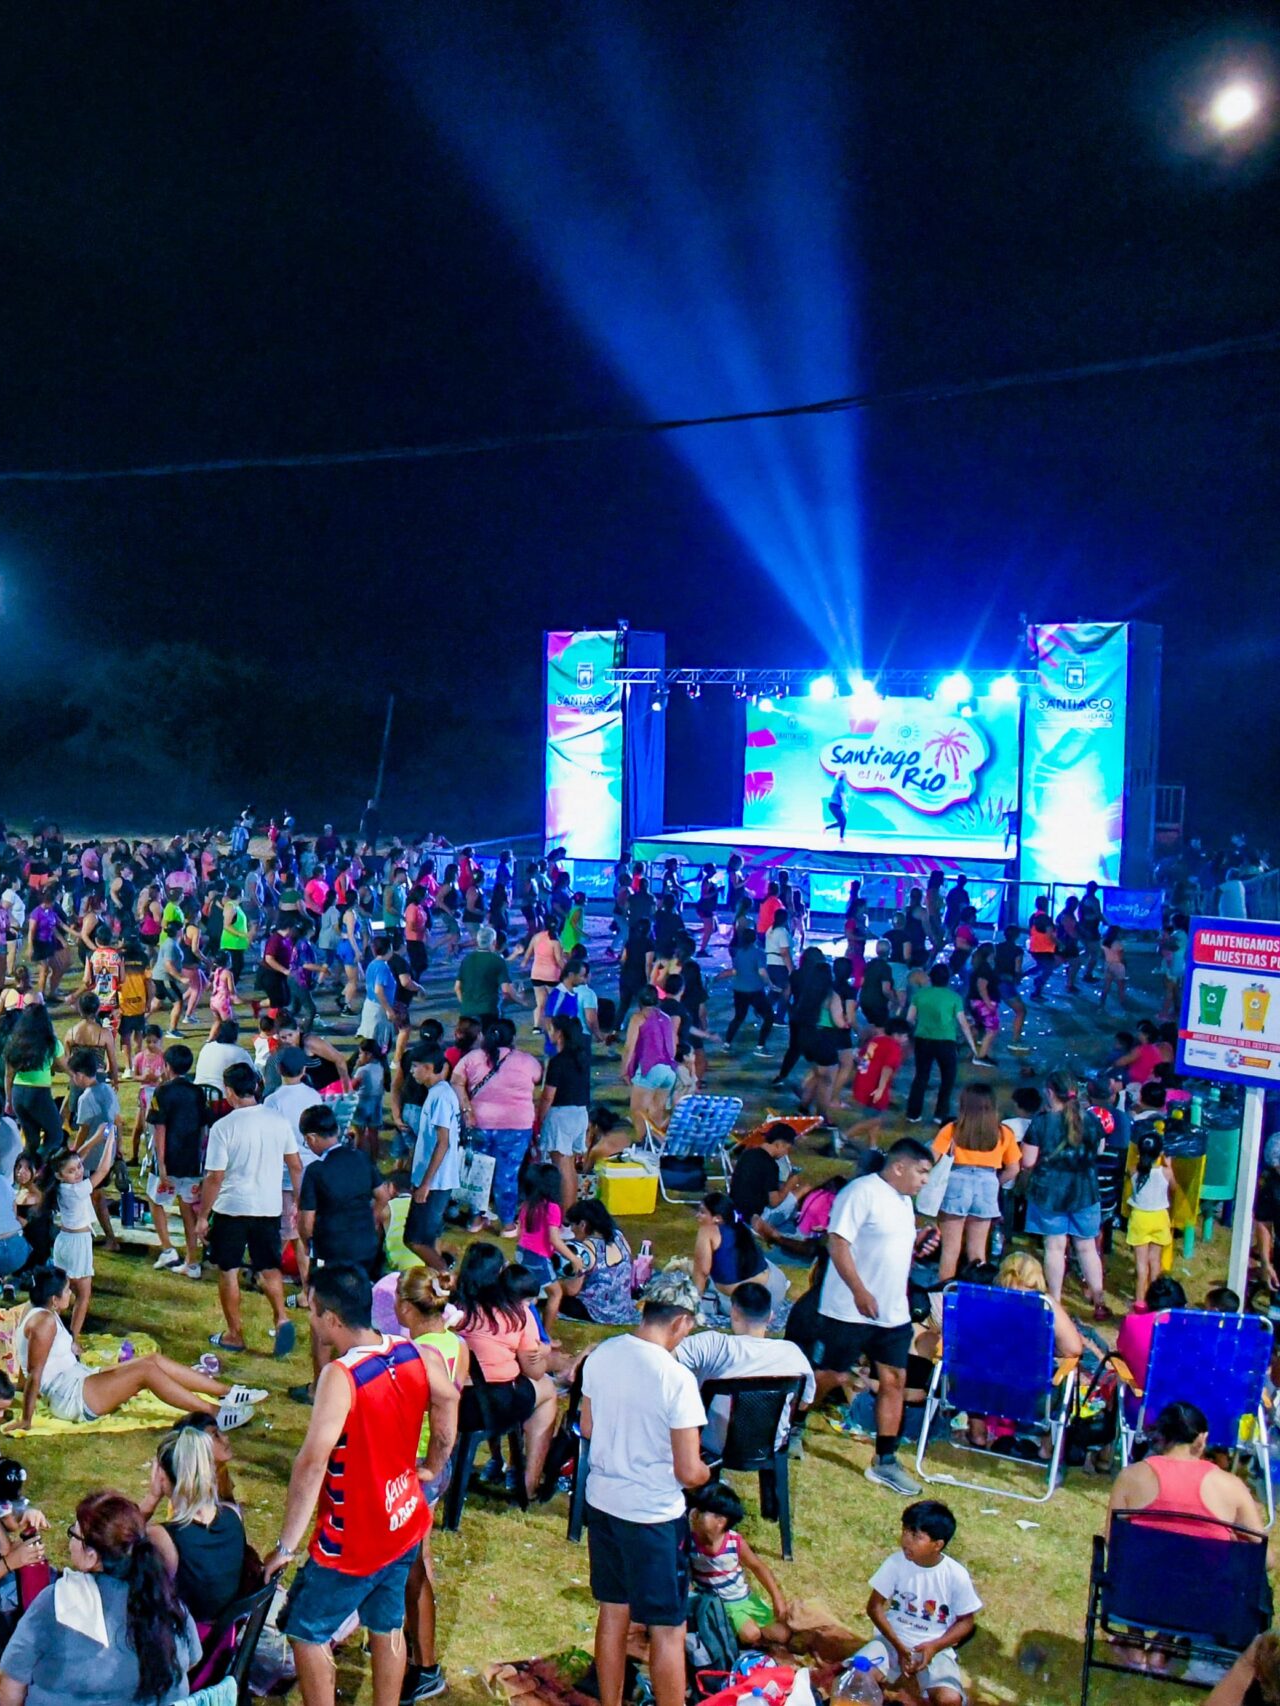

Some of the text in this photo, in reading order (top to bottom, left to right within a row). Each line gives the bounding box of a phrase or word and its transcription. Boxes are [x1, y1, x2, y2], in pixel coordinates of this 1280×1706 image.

[556, 695, 612, 706] SANTIAGO
[1038, 698, 1112, 710] SANTIAGO
[830, 745, 921, 779] Santiago
[1200, 932, 1280, 953] MANTENGAMOS
[1213, 949, 1268, 968] NUESTRAS
